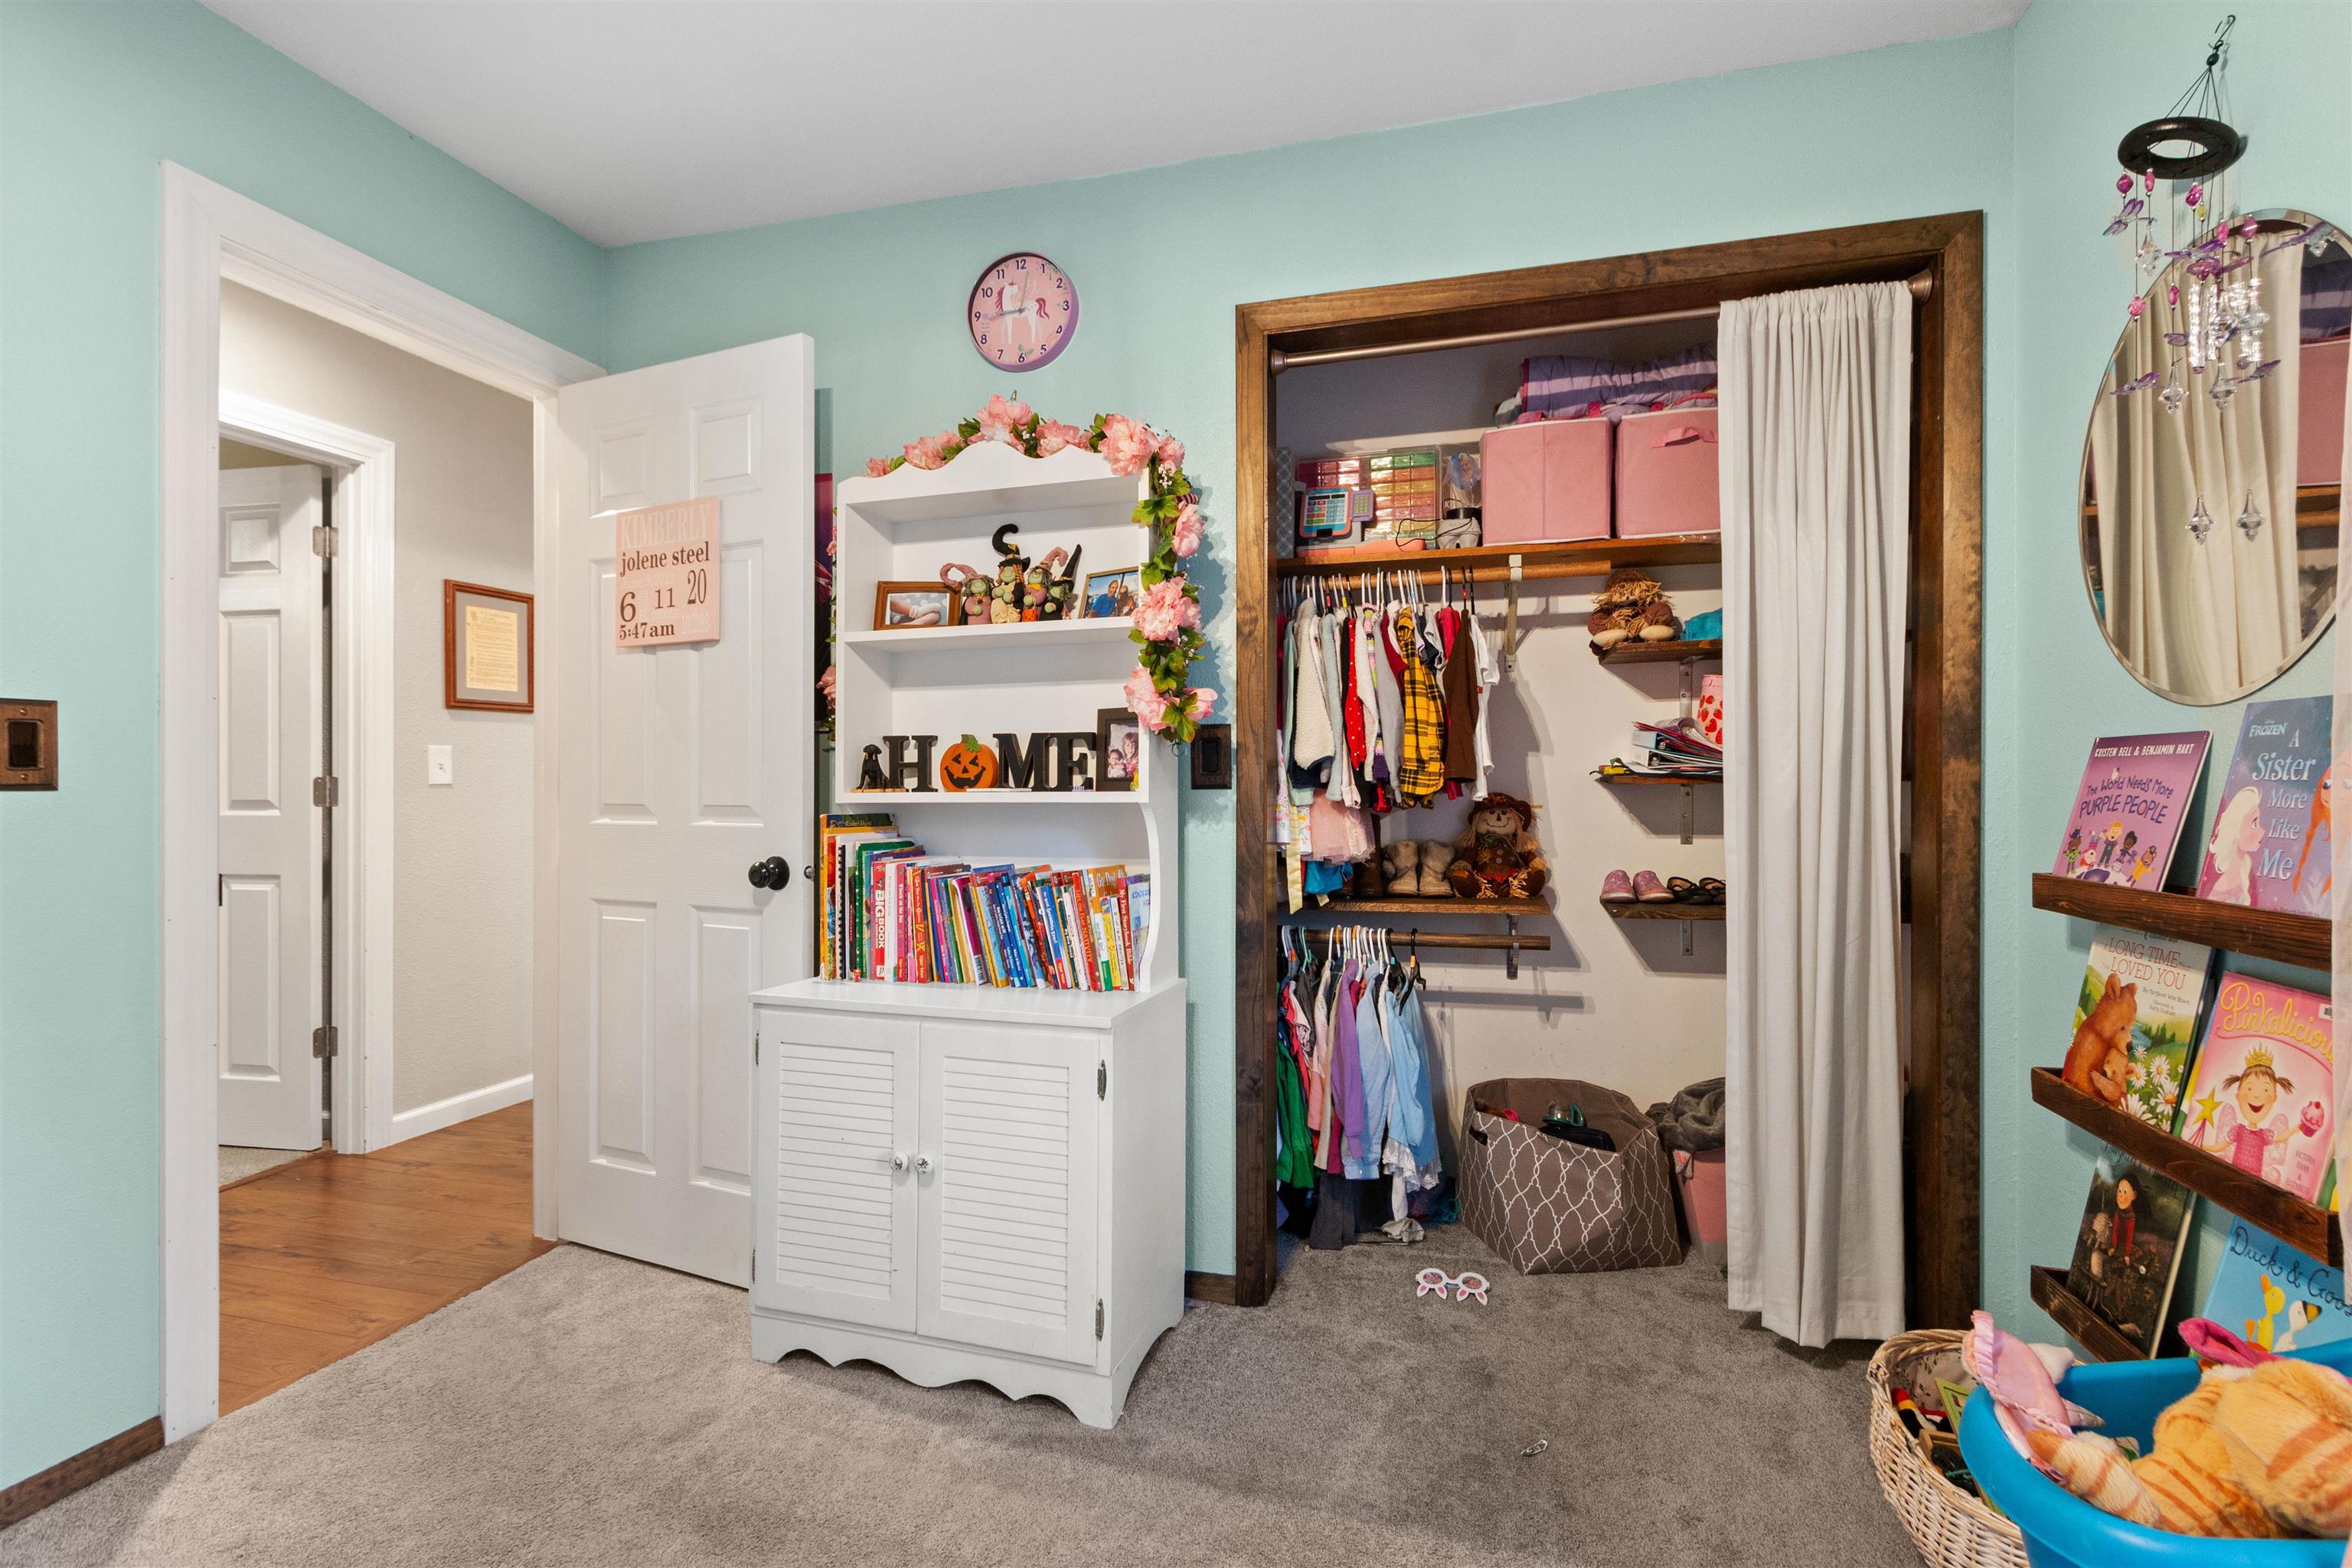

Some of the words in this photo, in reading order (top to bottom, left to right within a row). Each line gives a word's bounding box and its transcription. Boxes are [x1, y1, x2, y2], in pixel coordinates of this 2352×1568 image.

[996, 269, 1004, 279] 11
[1015, 259, 1027, 270] 12
[1041, 263, 1045, 274] 1
[981, 287, 993, 298] 10
[1056, 278, 1063, 289] 2
[1063, 300, 1070, 311] 3
[975, 312, 981, 322] 9
[981, 334, 988, 345] 8
[1056, 325, 1063, 334] 4
[998, 349, 1004, 360] 7
[1018, 352, 1025, 363] 6
[1040, 345, 1047, 354] 5
[619, 550, 667, 577] jolene
[671, 541, 710, 566] steel
[687, 568, 707, 604] 20
[619, 591, 636, 622] 6
[655, 587, 676, 609] 11
[2249, 722, 2288, 737] FROZEN
[2288, 728, 2300, 748] A
[2094, 747, 2117, 757] KRISTEN
[2118, 746, 2132, 756] BELL
[2134, 746, 2140, 756] &
[2141, 745, 2175, 756] BENJAMIN
[2176, 743, 2194, 754] HART
[2252, 752, 2317, 781] Sister
[2087, 786, 2097, 796] The
[2101, 776, 2125, 792] World
[2126, 776, 2152, 792] Needs
[2152, 778, 2174, 799] More
[2079, 794, 2122, 819] PURPLE
[2122, 795, 2168, 824] PEOPLE
[2267, 789, 2308, 809] More
[2267, 818, 2300, 840] Like
[2256, 848, 2295, 880] Me
[1119, 888, 1125, 897] My
[875, 890, 884, 917] BIG
[1121, 914, 1132, 946] Storybook
[1080, 926, 1093, 962] NATIVITY
[2108, 937, 2145, 959] LONG
[2148, 946, 2180, 969] TIME
[2111, 956, 2153, 981] LOVED
[2156, 968, 2187, 990] YOU
[2230, 1226, 2283, 1276] Duck
[2286, 1260, 2303, 1289] &
